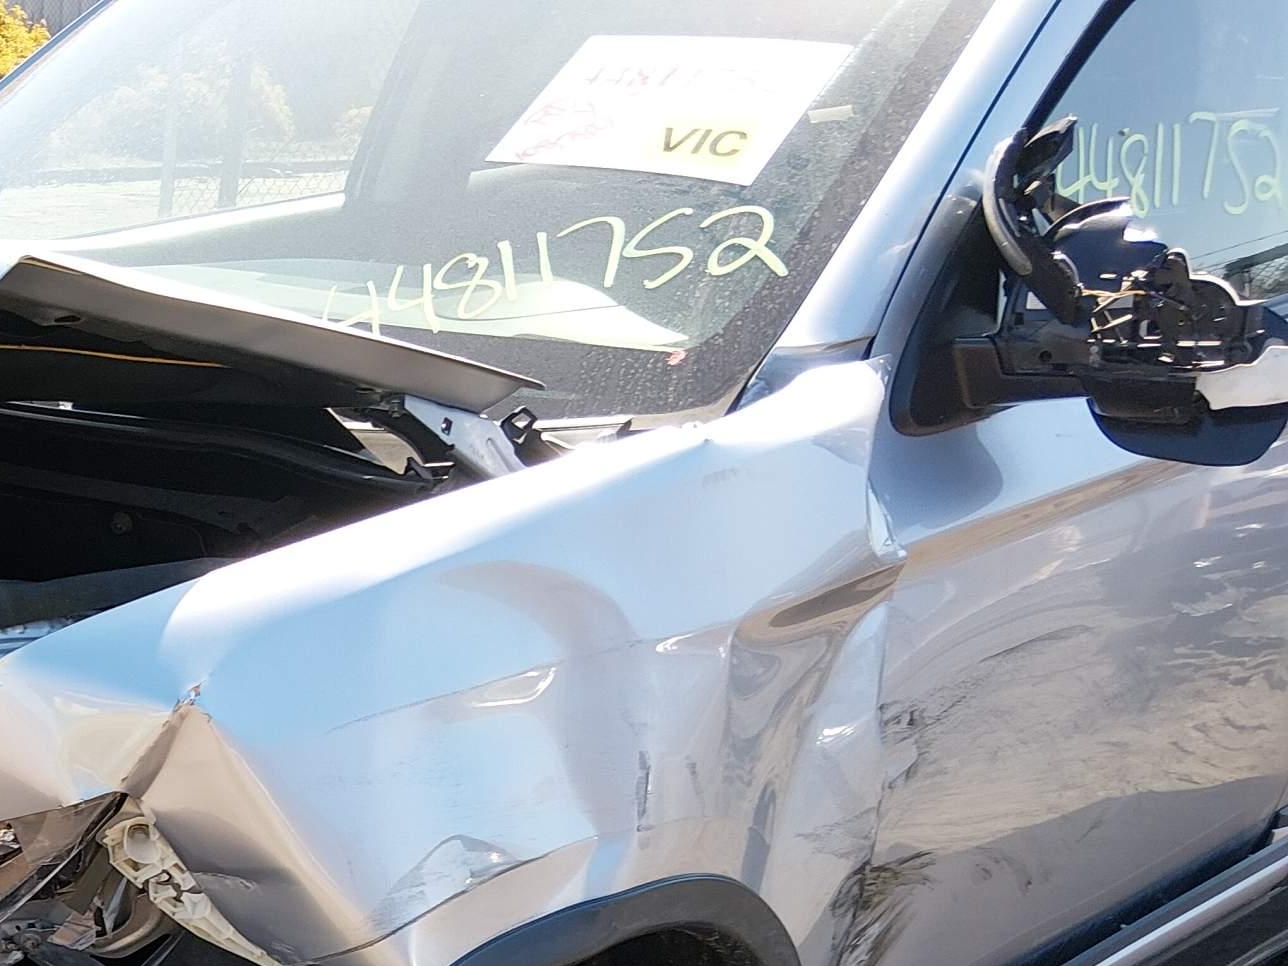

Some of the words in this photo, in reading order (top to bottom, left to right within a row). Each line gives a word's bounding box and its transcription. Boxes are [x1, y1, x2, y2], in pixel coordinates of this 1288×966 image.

[662, 127, 748, 157] VIC
[1054, 111, 1285, 218] 44811752
[321, 205, 789, 335] 44811752
